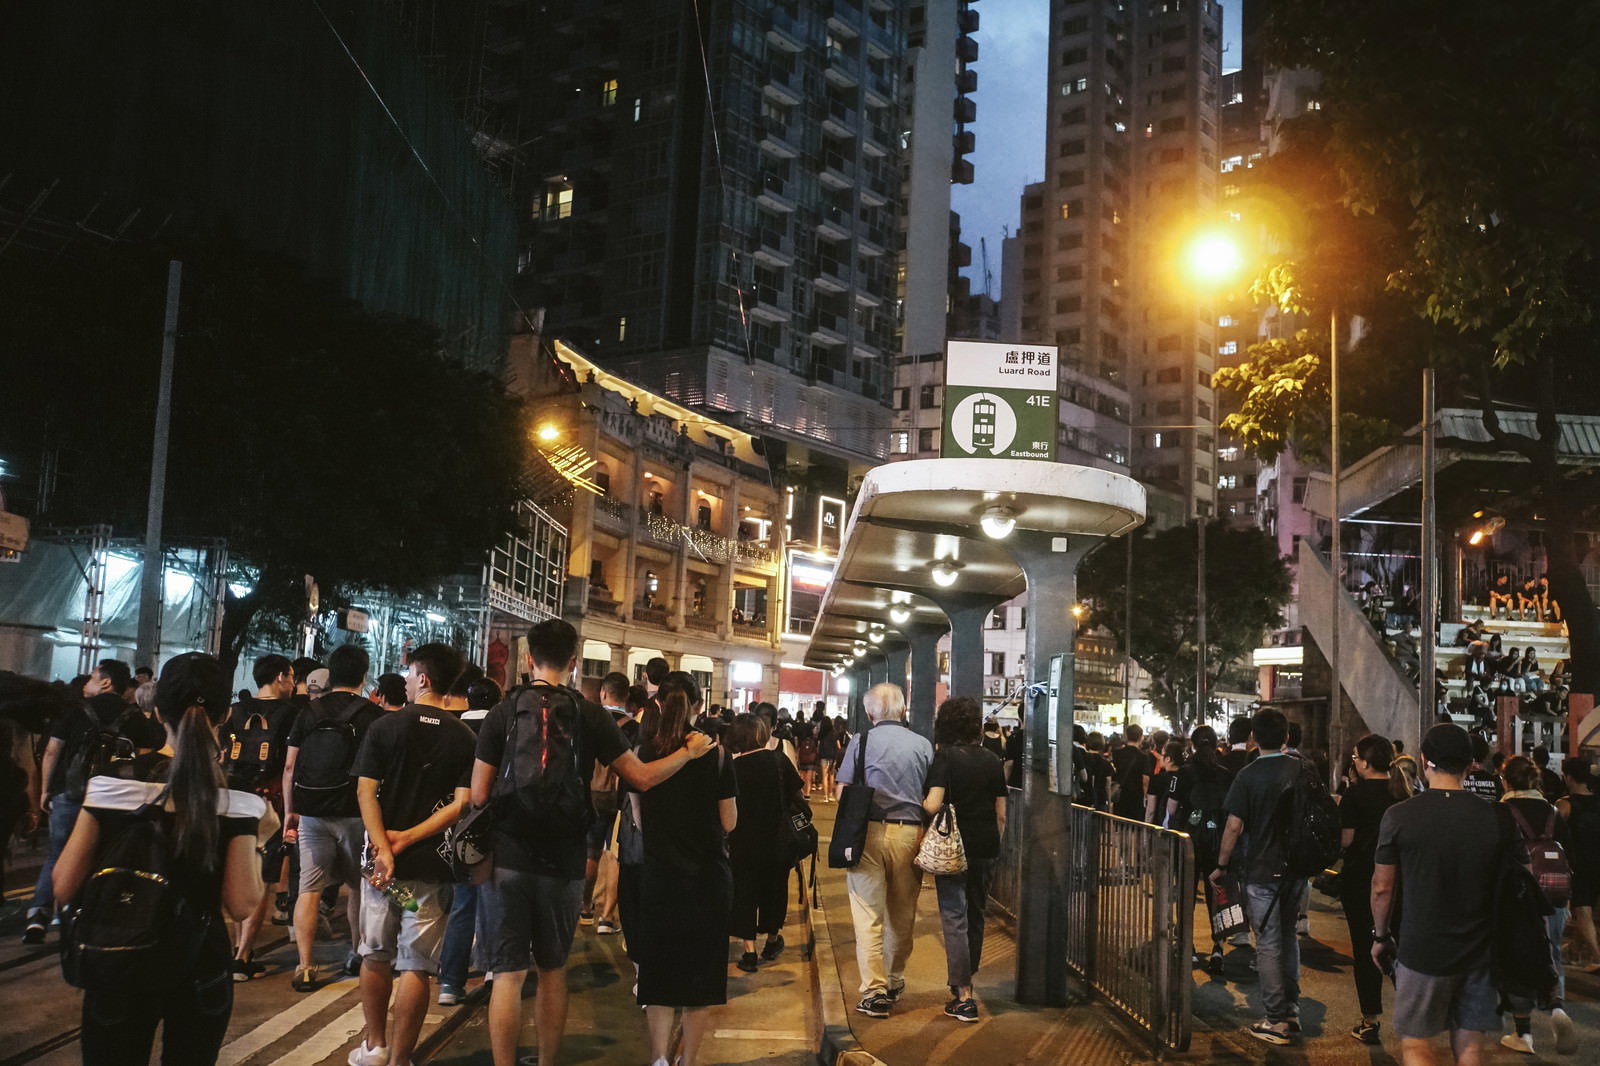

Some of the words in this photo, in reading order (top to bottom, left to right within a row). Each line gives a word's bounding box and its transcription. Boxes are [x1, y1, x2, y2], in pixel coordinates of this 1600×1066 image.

[1005, 351, 1051, 365] 盧押道
[998, 367, 1025, 375] Luard
[1027, 368, 1051, 376] Road
[1026, 395, 1050, 407] 41E
[1031, 441, 1049, 450] 東行
[1010, 450, 1049, 458] Eastbound
